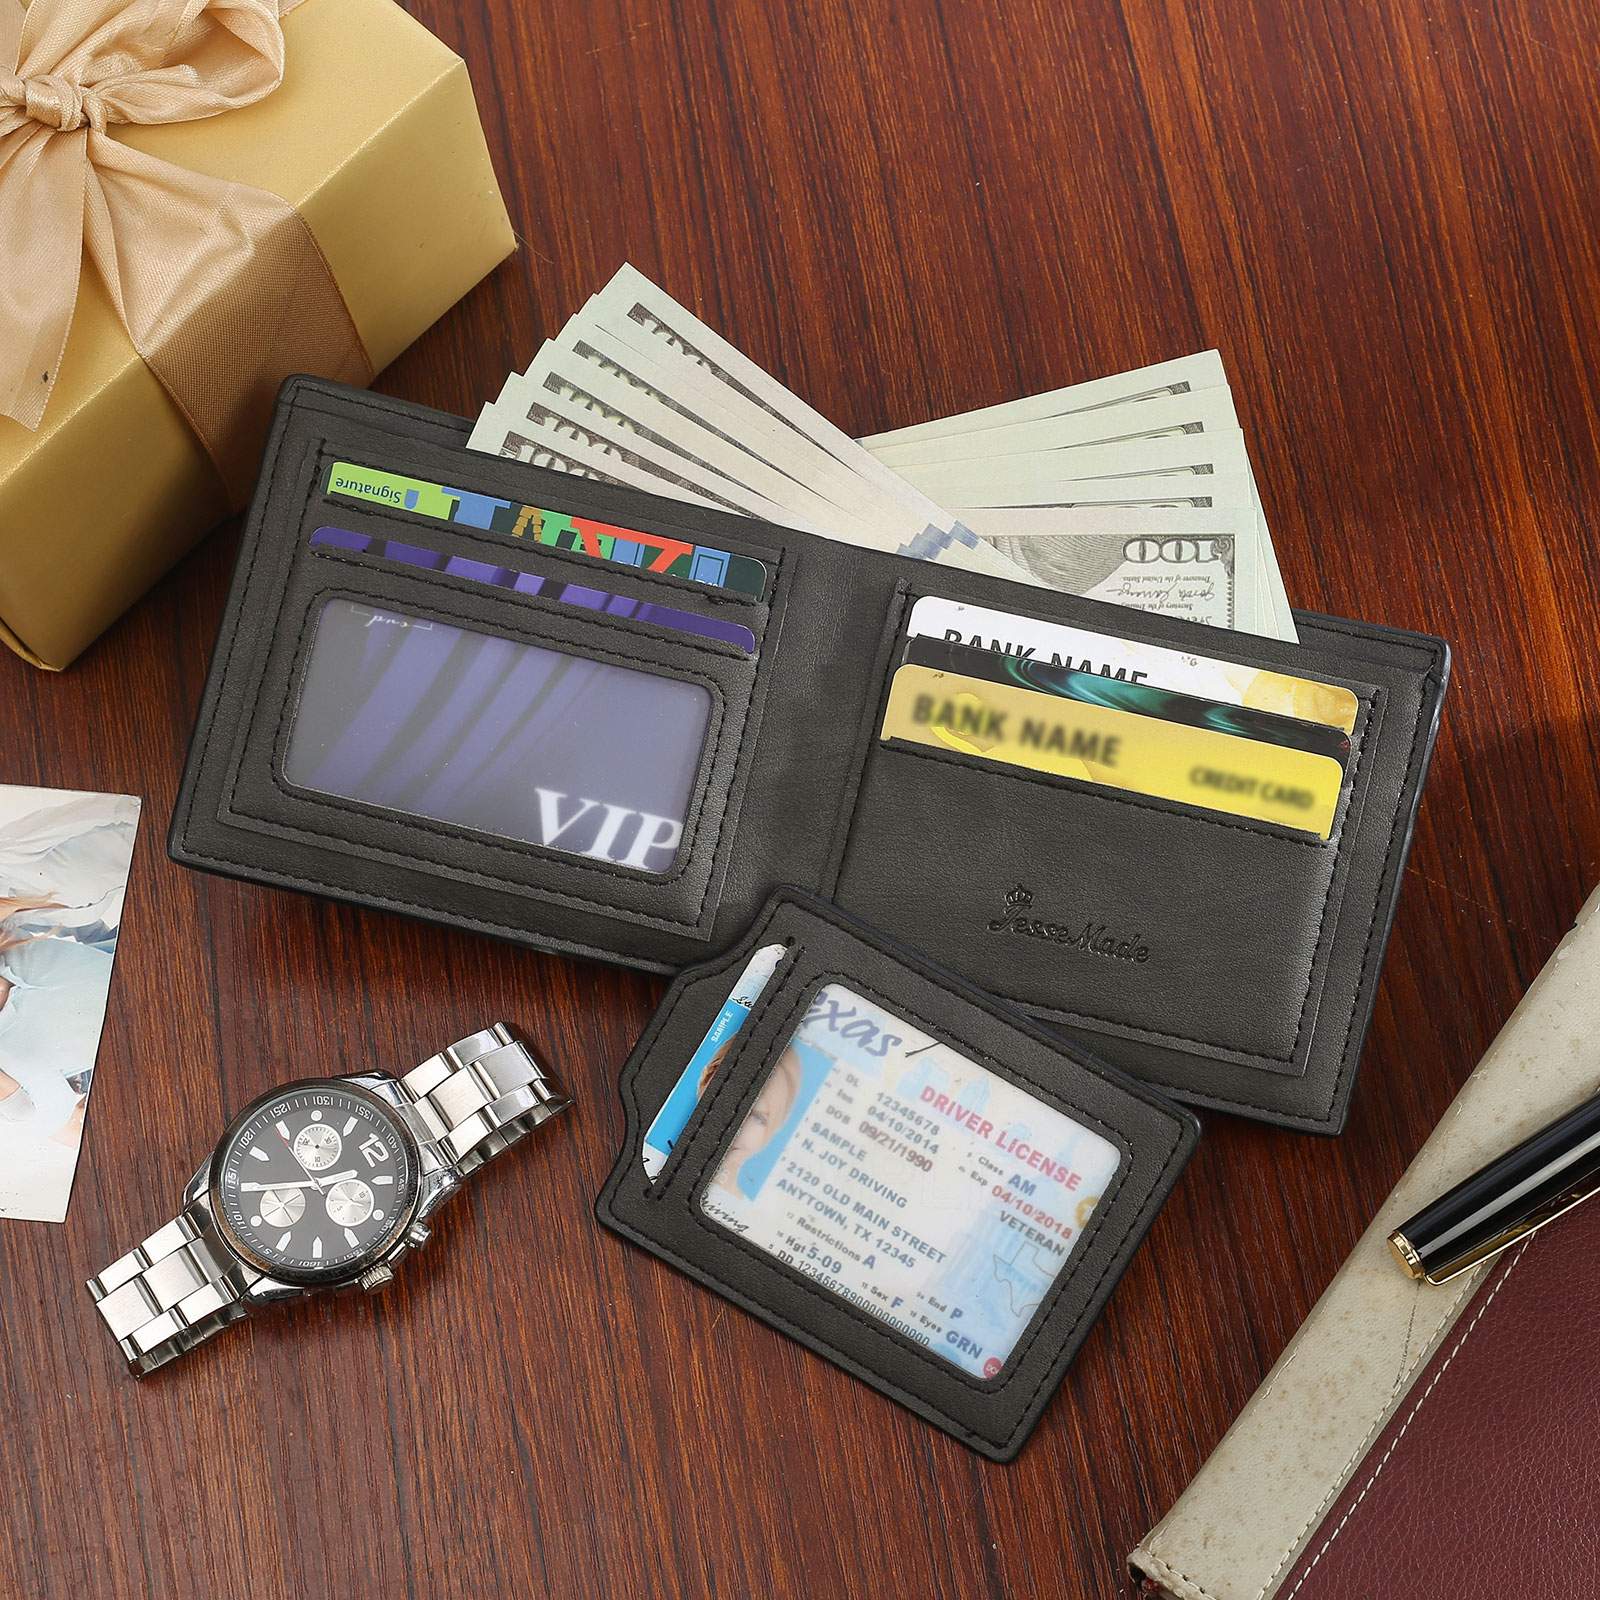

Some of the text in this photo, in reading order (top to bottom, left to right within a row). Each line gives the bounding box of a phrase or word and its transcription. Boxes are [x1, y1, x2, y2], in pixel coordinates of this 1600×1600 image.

[335, 477, 401, 503] Signature
[1122, 536, 1219, 564] 100
[910, 691, 1123, 766] BANK NAME
[1187, 764, 1316, 810] CREDIT CARD
[534, 787, 684, 869] VIP
[710, 1010, 733, 1044] SAMPLE
[867, 1106, 938, 1153] 04/10/2014
[877, 1092, 939, 1135] 12345678
[358, 1133, 388, 1167] 12
[811, 1122, 866, 1160] SAMPLE
[826, 1105, 932, 1171] DOB 09/21/1990
[920, 1086, 1080, 1190] DRIVER LICENSE
[801, 1138, 906, 1207] N. JOY DRIVING
[978, 1156, 1003, 1175] Class
[1008, 1174, 1036, 1195] AM
[776, 1179, 915, 1267] ANYTOWN, TX 12345
[786, 1161, 945, 1262] 2120 OLD MAIN STREET
[970, 1170, 1072, 1239] Exp 04/10/2018
[785, 1235, 805, 1253] Hgt
[806, 1246, 841, 1273] 5-09
[797, 1217, 860, 1260] Restrictions
[861, 1254, 875, 1269] A
[1000, 1211, 1064, 1256] VETERAN
[870, 1286, 888, 1301] Sex
[890, 1296, 903, 1308] F
[928, 1296, 946, 1312] End
[949, 1307, 962, 1318] P
[919, 1315, 941, 1332] Eyes
[946, 1330, 982, 1358] GRN
